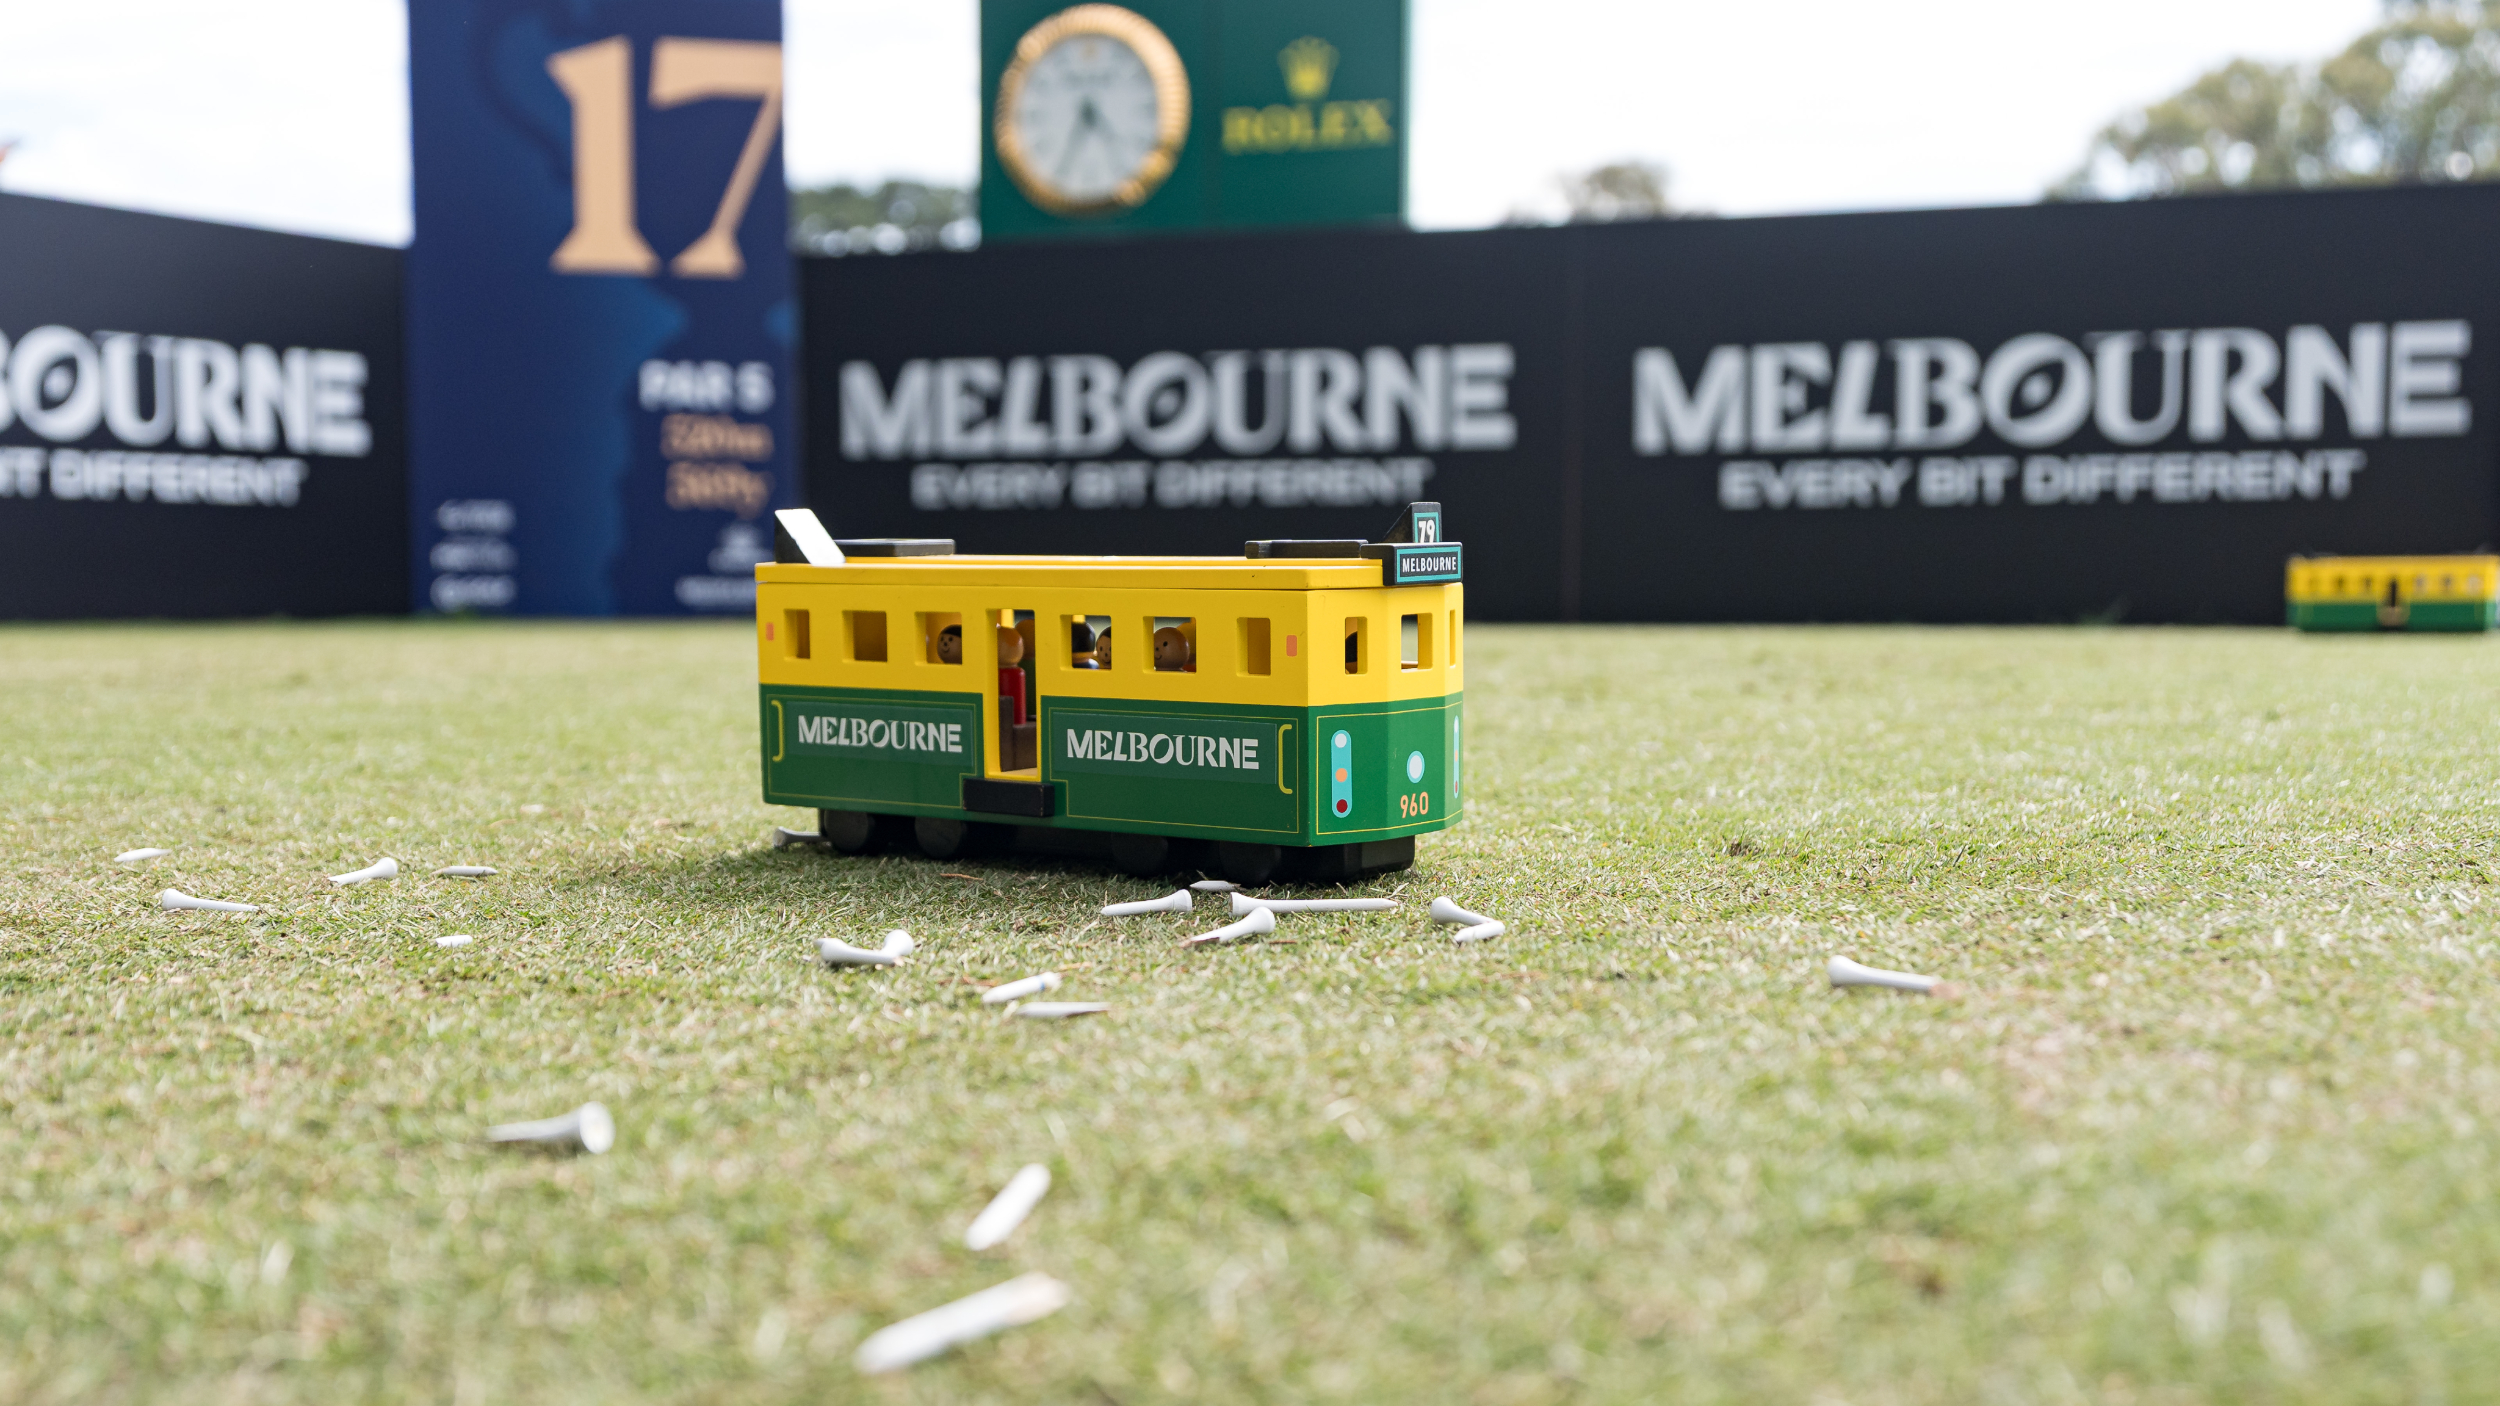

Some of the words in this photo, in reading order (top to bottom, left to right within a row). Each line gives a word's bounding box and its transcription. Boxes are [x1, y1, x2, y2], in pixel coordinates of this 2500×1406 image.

[1222, 98, 1393, 155] ROLEX
[545, 34, 783, 280] 17
[0, 325, 372, 457] OURNE
[639, 359, 735, 412] PAR
[839, 342, 1517, 461] MELBOURNE
[1632, 319, 2472, 456] MELBOURNE
[50, 449, 308, 506] DIFFERENT
[910, 462, 1066, 509] EVERY
[1070, 461, 1153, 508] BIT
[1154, 457, 1434, 509] DIFFERENT
[1719, 457, 1914, 510] EVERY
[1918, 456, 2017, 508] BIT
[2021, 449, 2366, 504] DIFFERENT
[1418, 520, 1435, 543] 79
[1402, 556, 1457, 573] MELBOURNE
[798, 715, 962, 753] MELBOURNE
[1067, 729, 1259, 770] MELBOURNE
[1400, 791, 1429, 819] 960
